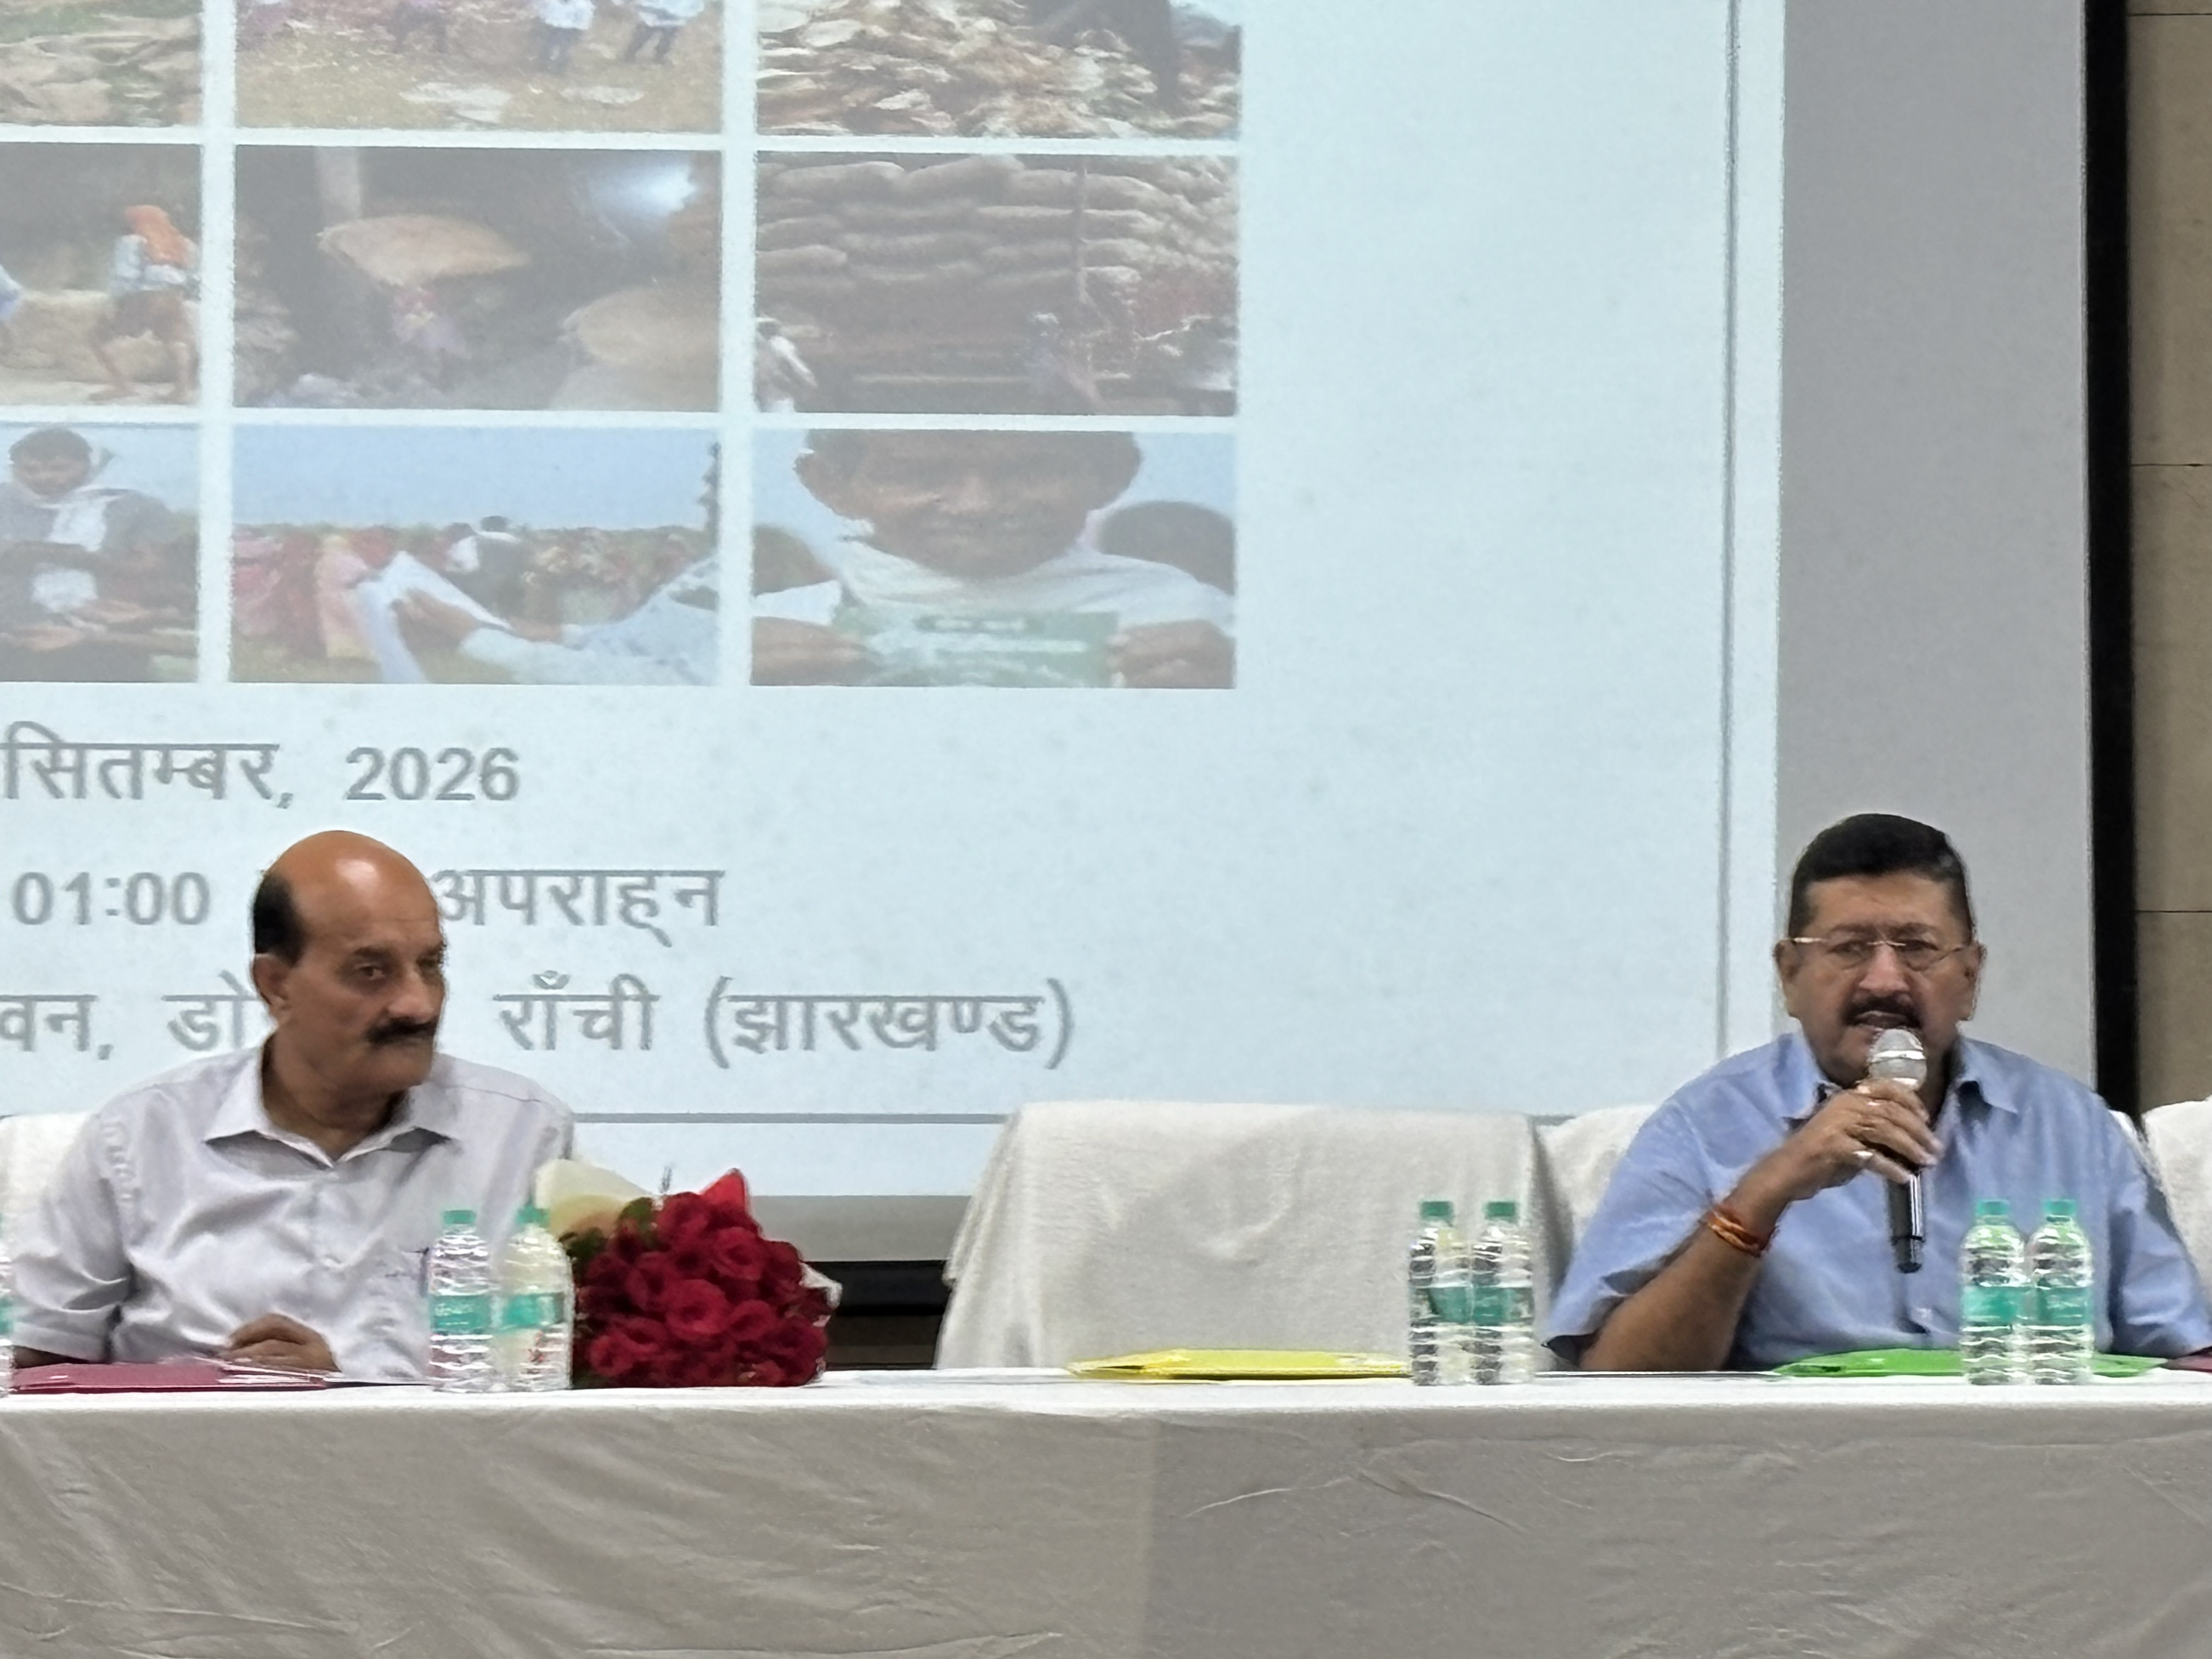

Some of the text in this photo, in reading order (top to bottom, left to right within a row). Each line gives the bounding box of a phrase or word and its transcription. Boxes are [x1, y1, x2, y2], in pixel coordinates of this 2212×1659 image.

[0, 721, 520, 809] सितम्बर, 2026
[12, 871, 211, 926] 01:00
[492, 969, 662, 1051] राँची
[704, 975, 1074, 1070] (झारखण्ड)
